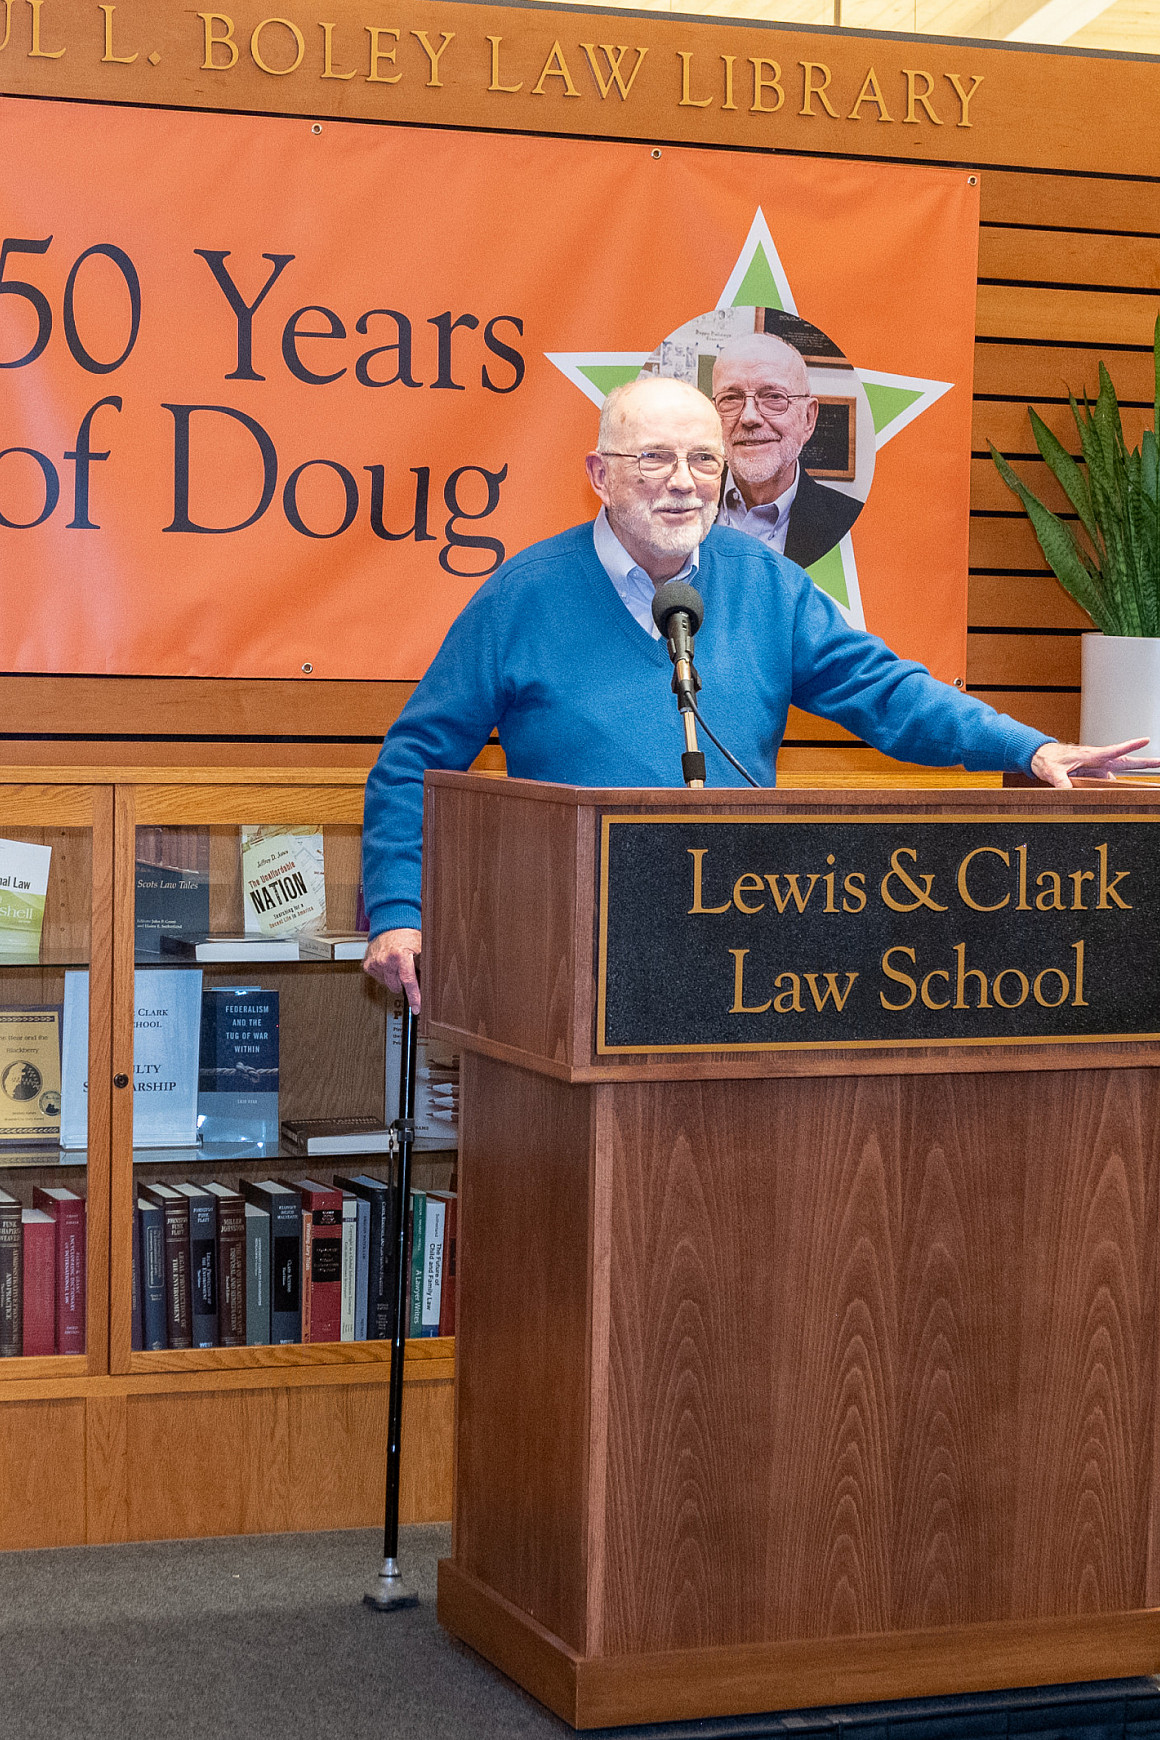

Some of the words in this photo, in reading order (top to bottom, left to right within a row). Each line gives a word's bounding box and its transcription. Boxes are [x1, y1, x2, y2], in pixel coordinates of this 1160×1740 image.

[98, 5, 162, 66] L.
[197, 12, 456, 88] BOLEY
[486, 36, 649, 101] LAW
[676, 51, 985, 128] LIBRARY
[0, 234, 141, 374] 50
[193, 248, 525, 393] Years
[0, 395, 123, 530] of
[161, 402, 508, 577] Doug
[13, 877, 31, 890] Law
[137, 880, 158, 889] Scots
[160, 880, 176, 889] Law
[179, 881, 198, 890] Tales
[248, 879, 260, 889] The
[260, 861, 296, 884] Unaffordable
[686, 847, 867, 915] Lewis
[880, 848, 949, 913] &
[957, 843, 1133, 912] Clark
[249, 871, 308, 914] NATION
[273, 906, 294, 919] Searching
[297, 906, 314, 917] America
[728, 949, 859, 1014] Law
[879, 940, 1089, 1011] School
[138, 1008, 168, 1017] CLARK
[225, 1005, 269, 1013] FEDERALISM
[226, 1032, 239, 1040] TUG
[234, 1045, 260, 1053] WITHIN
[413, 1276, 421, 1301] Lawyer
[425, 1274, 434, 1296] Family
[181, 1319, 187, 1329] OF
[413, 1302, 421, 1325] Writes
